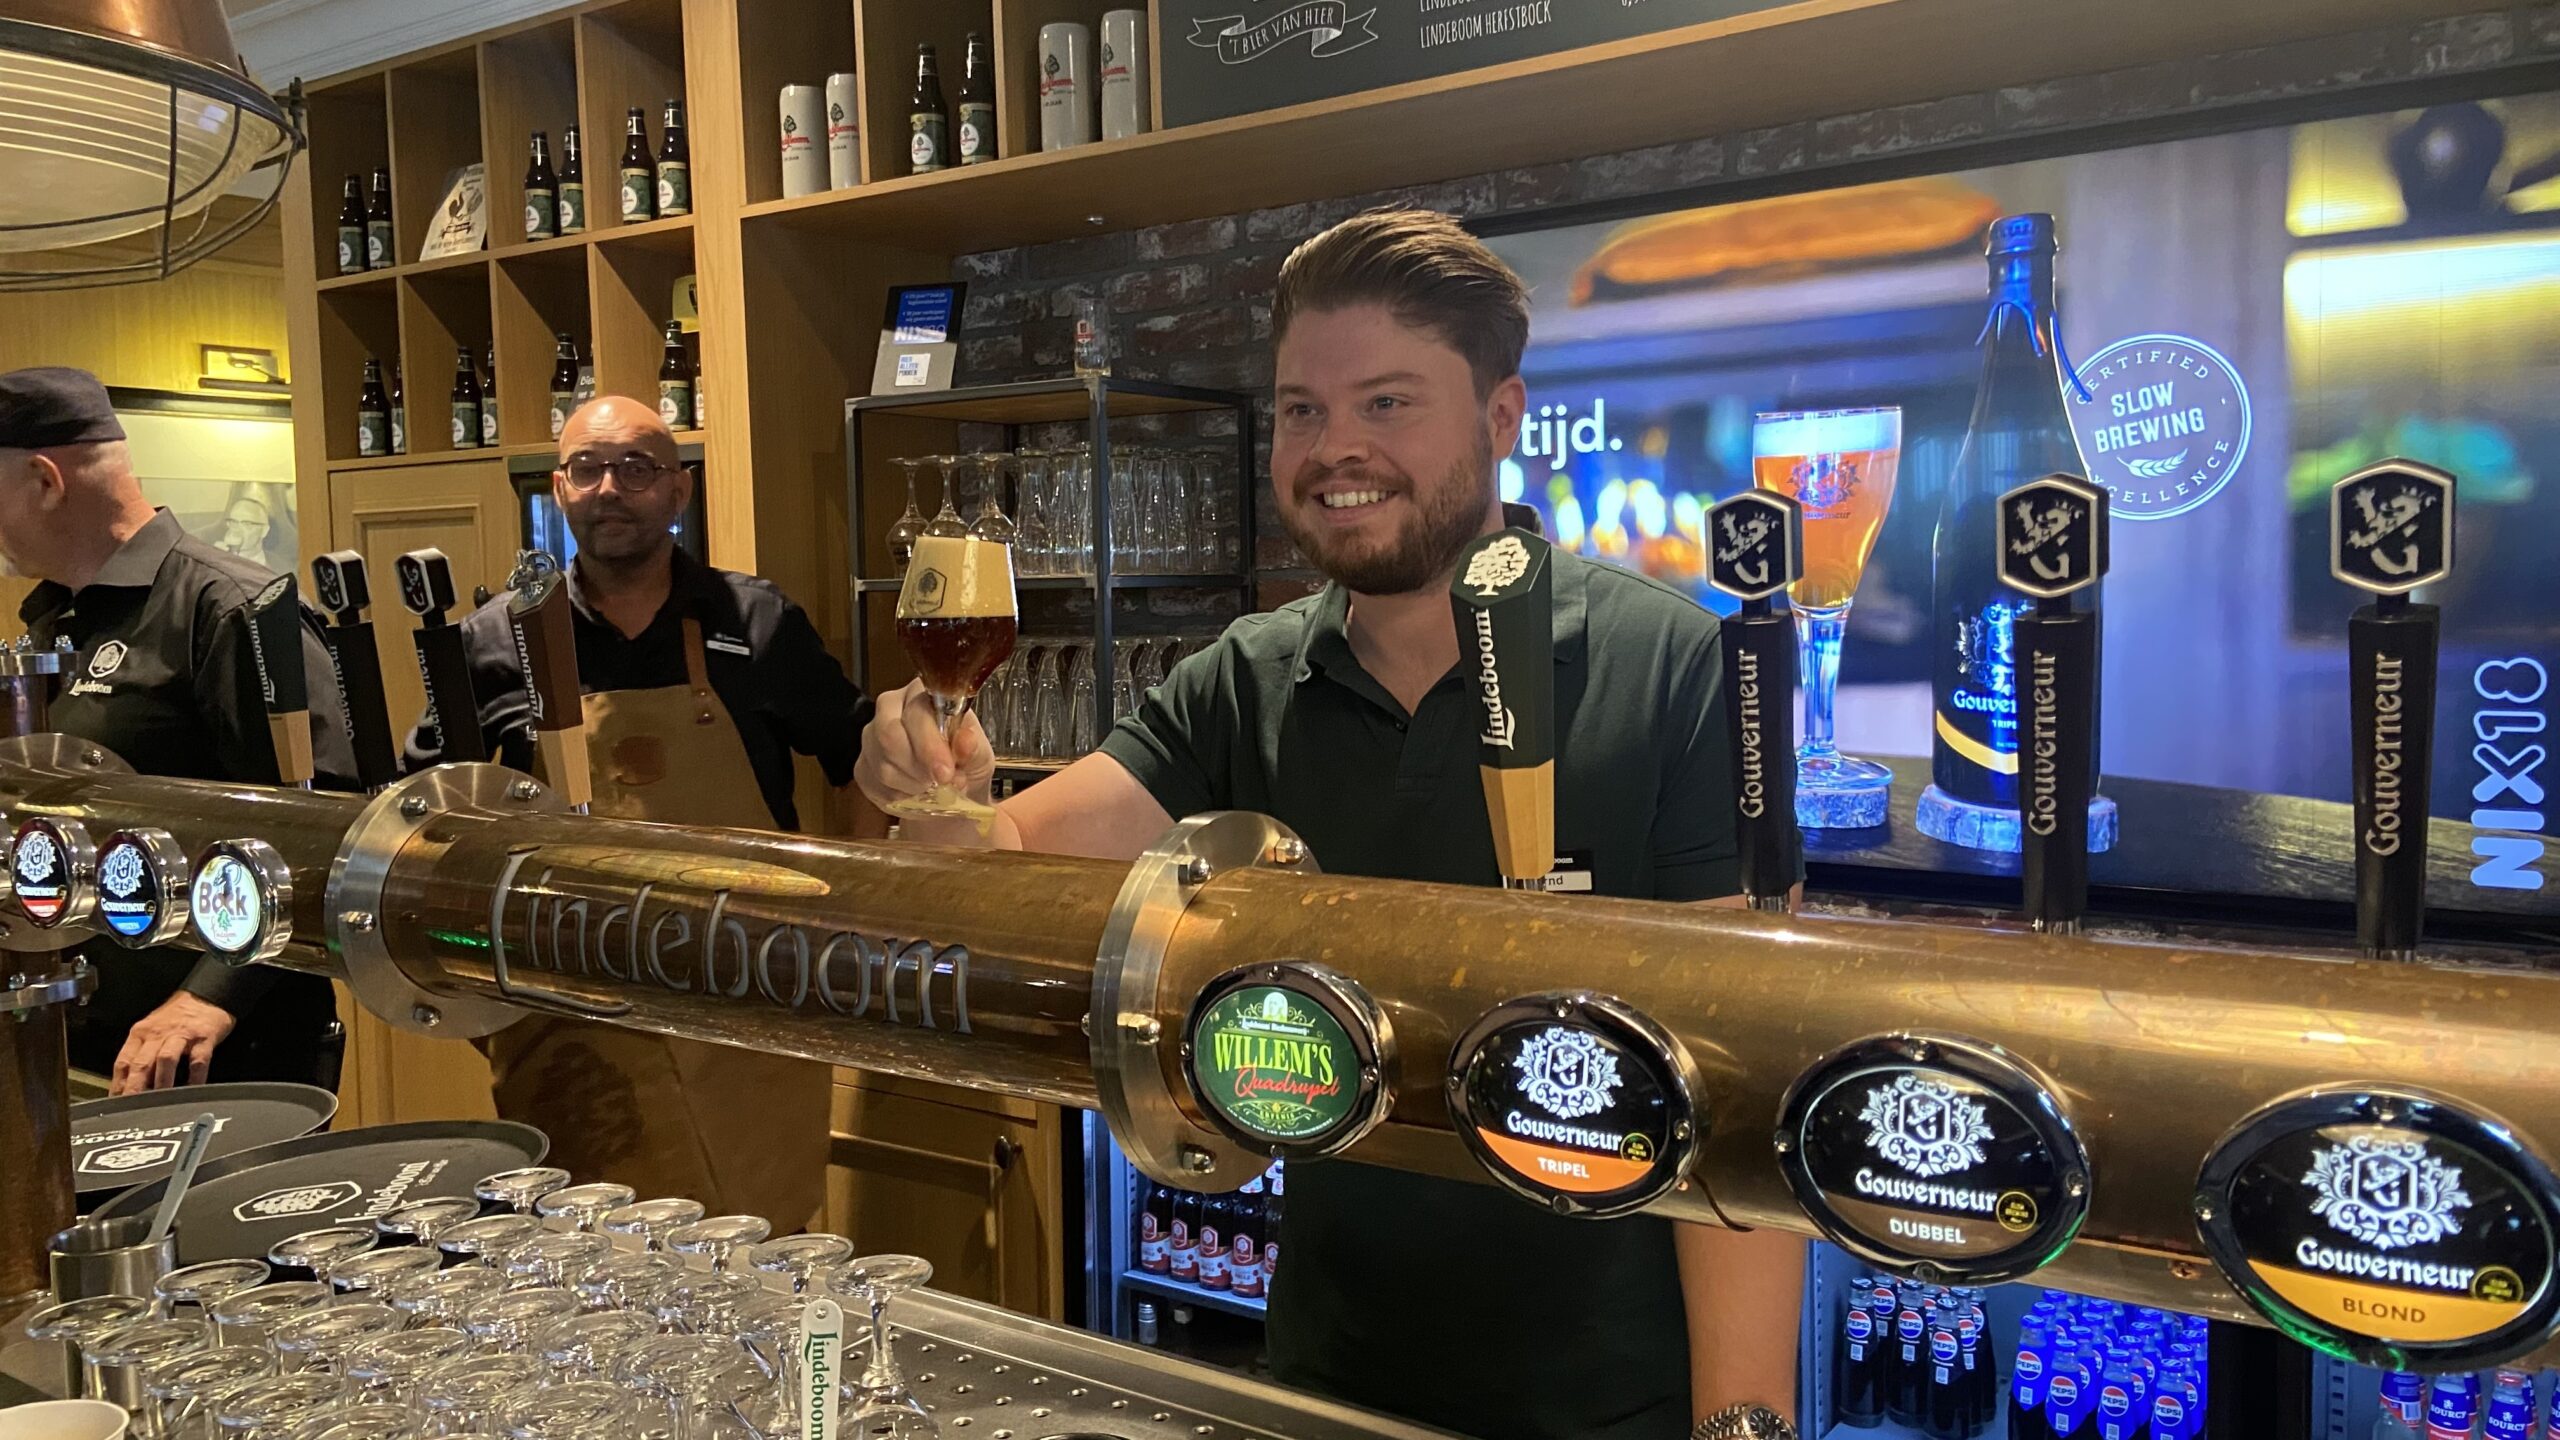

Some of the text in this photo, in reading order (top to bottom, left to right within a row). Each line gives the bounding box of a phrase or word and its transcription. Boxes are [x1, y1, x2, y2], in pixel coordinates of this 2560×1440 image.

[1242, 29, 1270, 54] BIER
[1271, 11, 1301, 37] VAN
[1305, 7, 1333, 26] HIER
[1420, 1, 1552, 48] LINDEBOOM HERFSTBOCK
[2111, 381, 2174, 418] SLOW
[1521, 398, 1622, 470] tijd.
[2094, 407, 2206, 453] BREWING
[2087, 440, 2229, 504] XCELLENCE
[1475, 608, 1515, 750] Lindeboom
[1738, 648, 1764, 818] Gouverneur
[2028, 650, 2056, 836] Gouverneur
[2365, 652, 2402, 856] Gouverneur
[2470, 657, 2548, 889] NIX18
[198, 881, 248, 916] Bock
[491, 845, 972, 1035] Lindeboom
[1214, 1032, 1334, 1086] WILLEM'S
[1235, 1064, 1341, 1105] Quadrupel
[1507, 1111, 1623, 1151] Gouverneur
[1537, 1157, 1590, 1178] TRIPEL
[1855, 1167, 1998, 1212] Gouverneur
[1889, 1217, 1966, 1244] DUBBEL
[2296, 1237, 2474, 1290] Gouverneur
[1900, 1321, 1921, 1329] PEPSI
[2343, 1297, 2426, 1323] BLOND
[1934, 1341, 1956, 1351] PEPSI
[2017, 1359, 2041, 1371] PEPSI
[804, 1330, 839, 1440] Lindeboom
[2051, 1385, 2076, 1396] PEPSI
[2102, 1396, 2128, 1407] PEPSI
[2156, 1406, 2182, 1416] PEPSI
[2430, 1405, 2467, 1419] SOURCY
[2488, 1416, 2526, 1432] SOURCY
